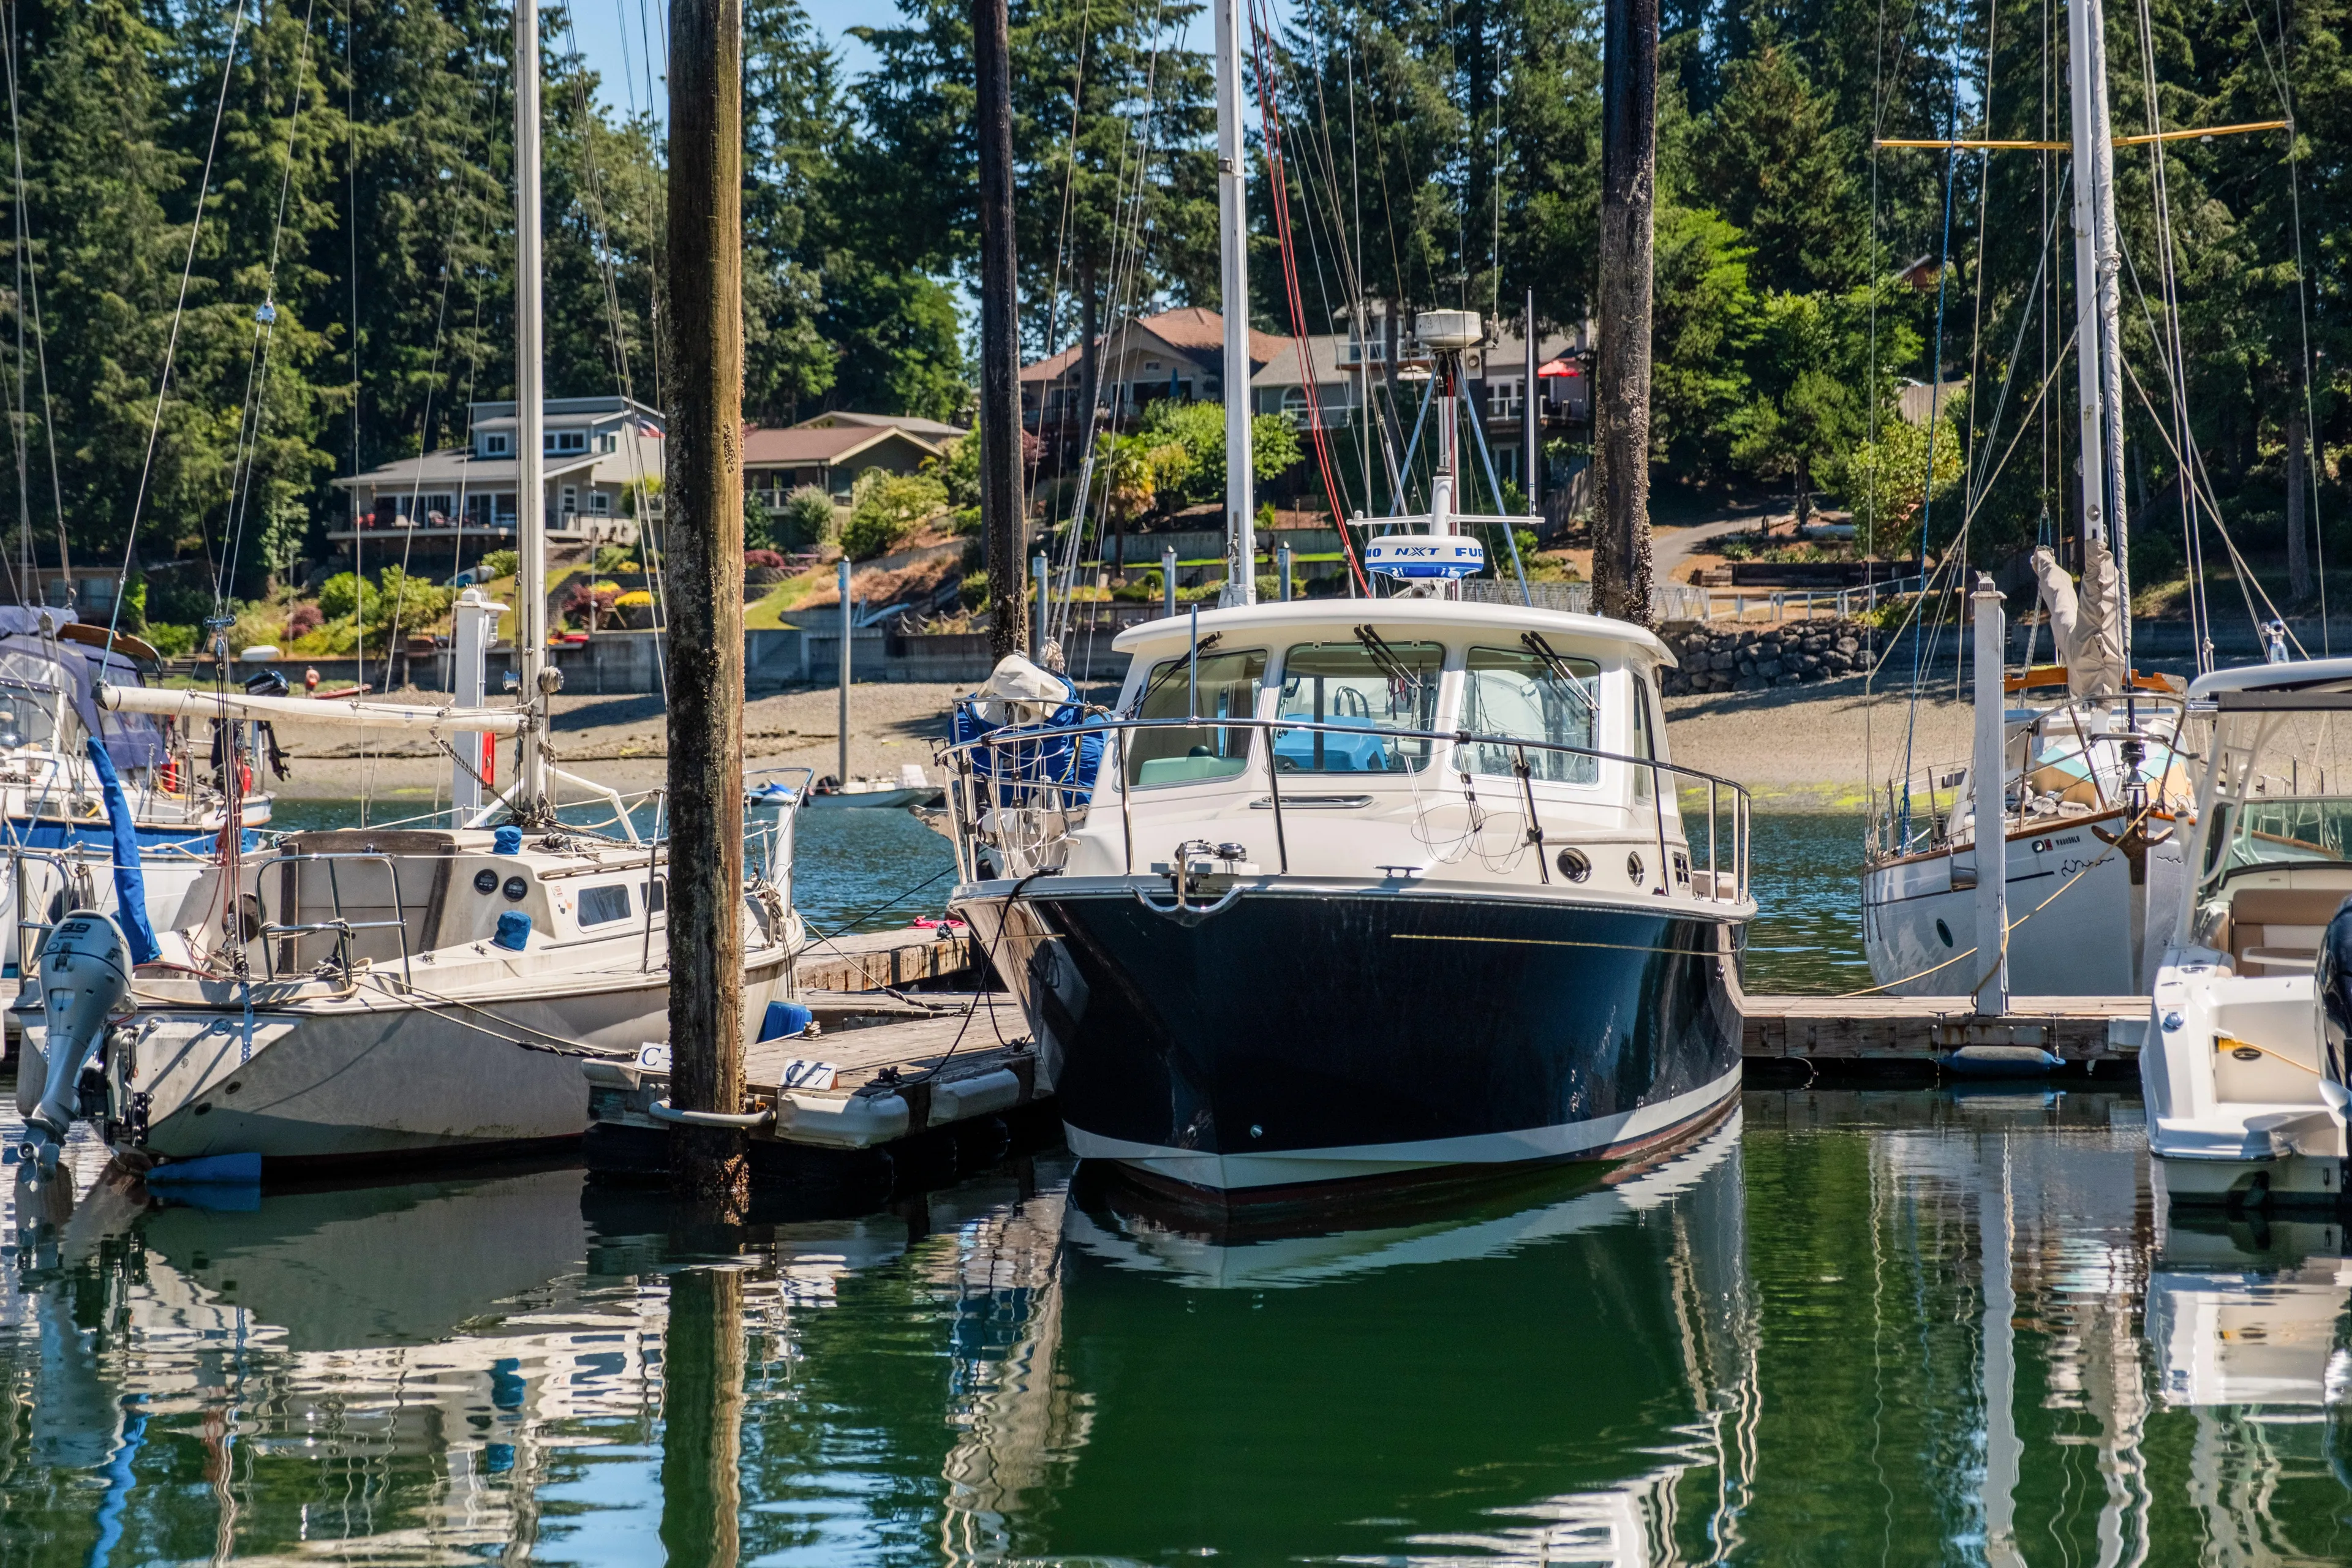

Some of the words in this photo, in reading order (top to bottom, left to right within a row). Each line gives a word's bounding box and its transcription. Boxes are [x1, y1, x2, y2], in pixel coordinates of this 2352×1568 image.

[1395, 547, 1440, 556] NXT
[641, 1047, 671, 1066] C-
[785, 1063, 832, 1085] C-7
